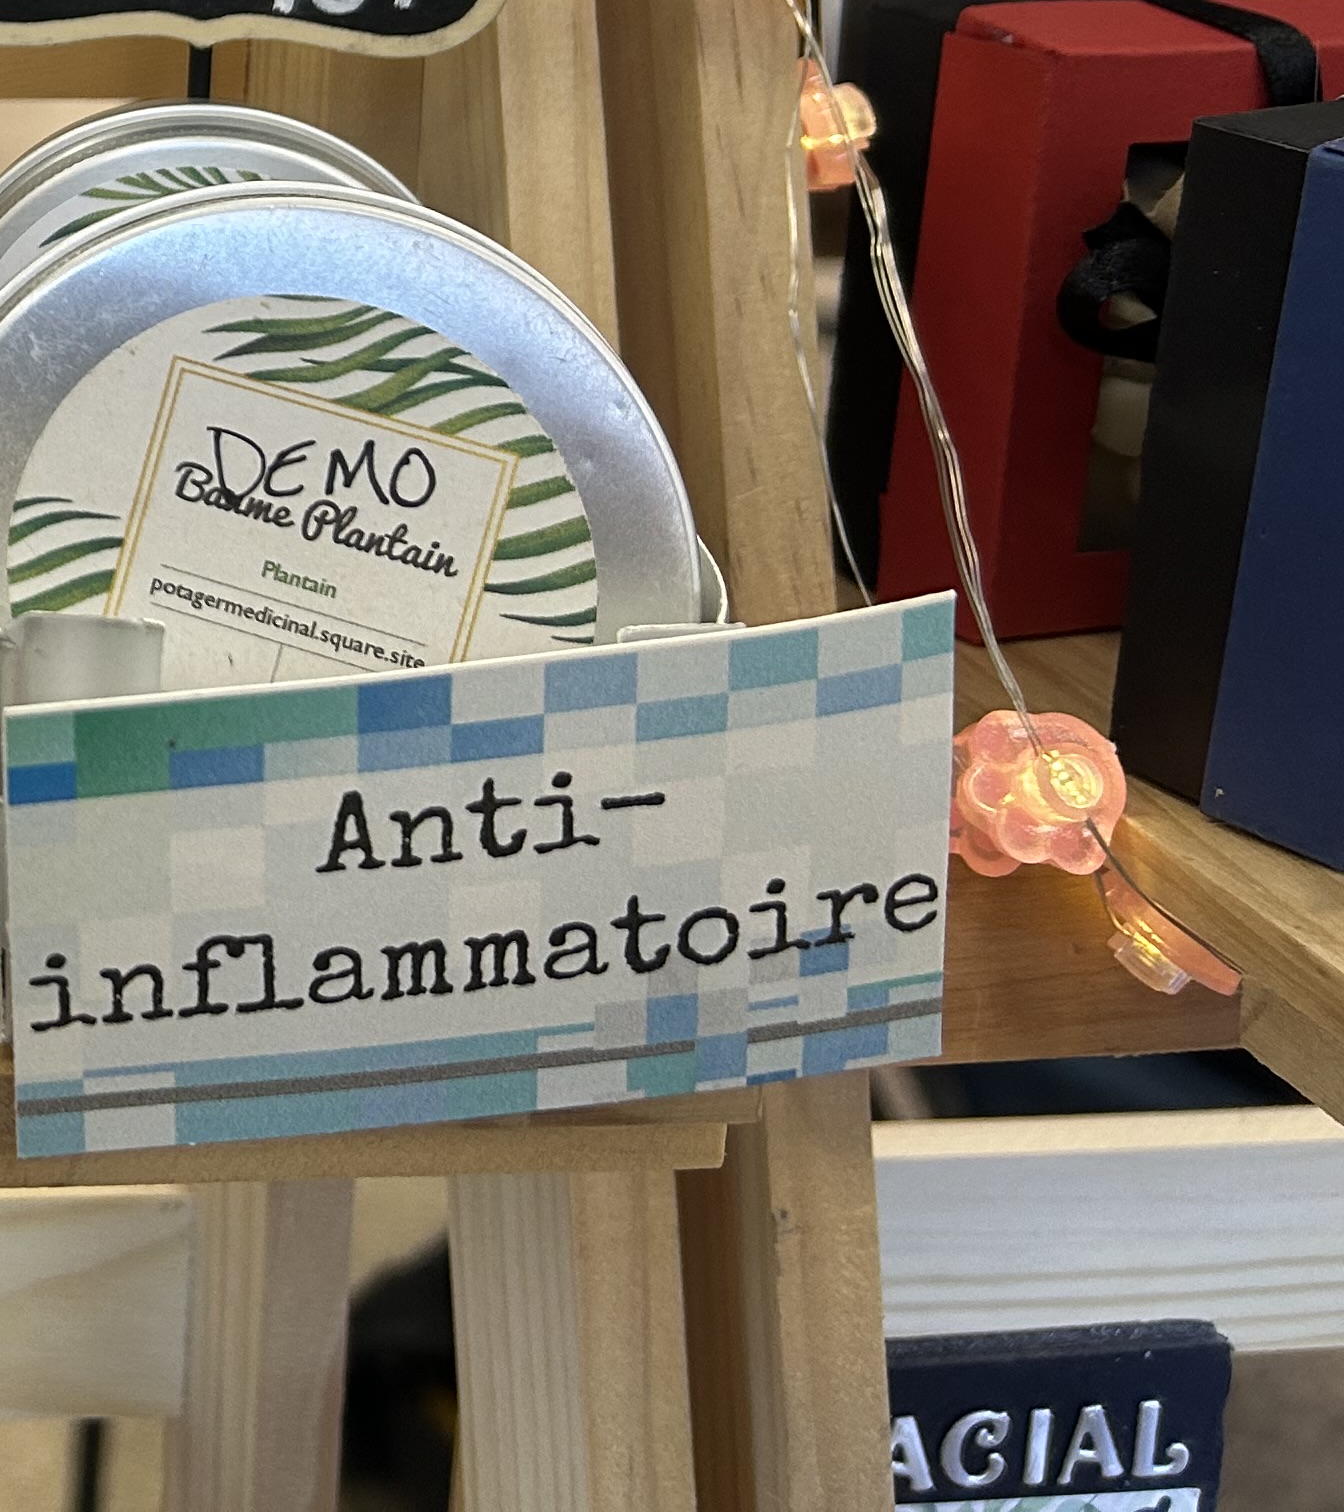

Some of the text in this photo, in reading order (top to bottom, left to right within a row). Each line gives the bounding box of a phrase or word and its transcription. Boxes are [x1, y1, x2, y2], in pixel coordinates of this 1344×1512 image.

[207, 425, 436, 508] DEMO
[261, 559, 337, 599] Plantain
[301, 499, 459, 578] Plantain
[149, 575, 426, 668] potagermedicinal.square.site
[316, 771, 665, 874] Anti-
[29, 868, 939, 1033] inflammatoire
